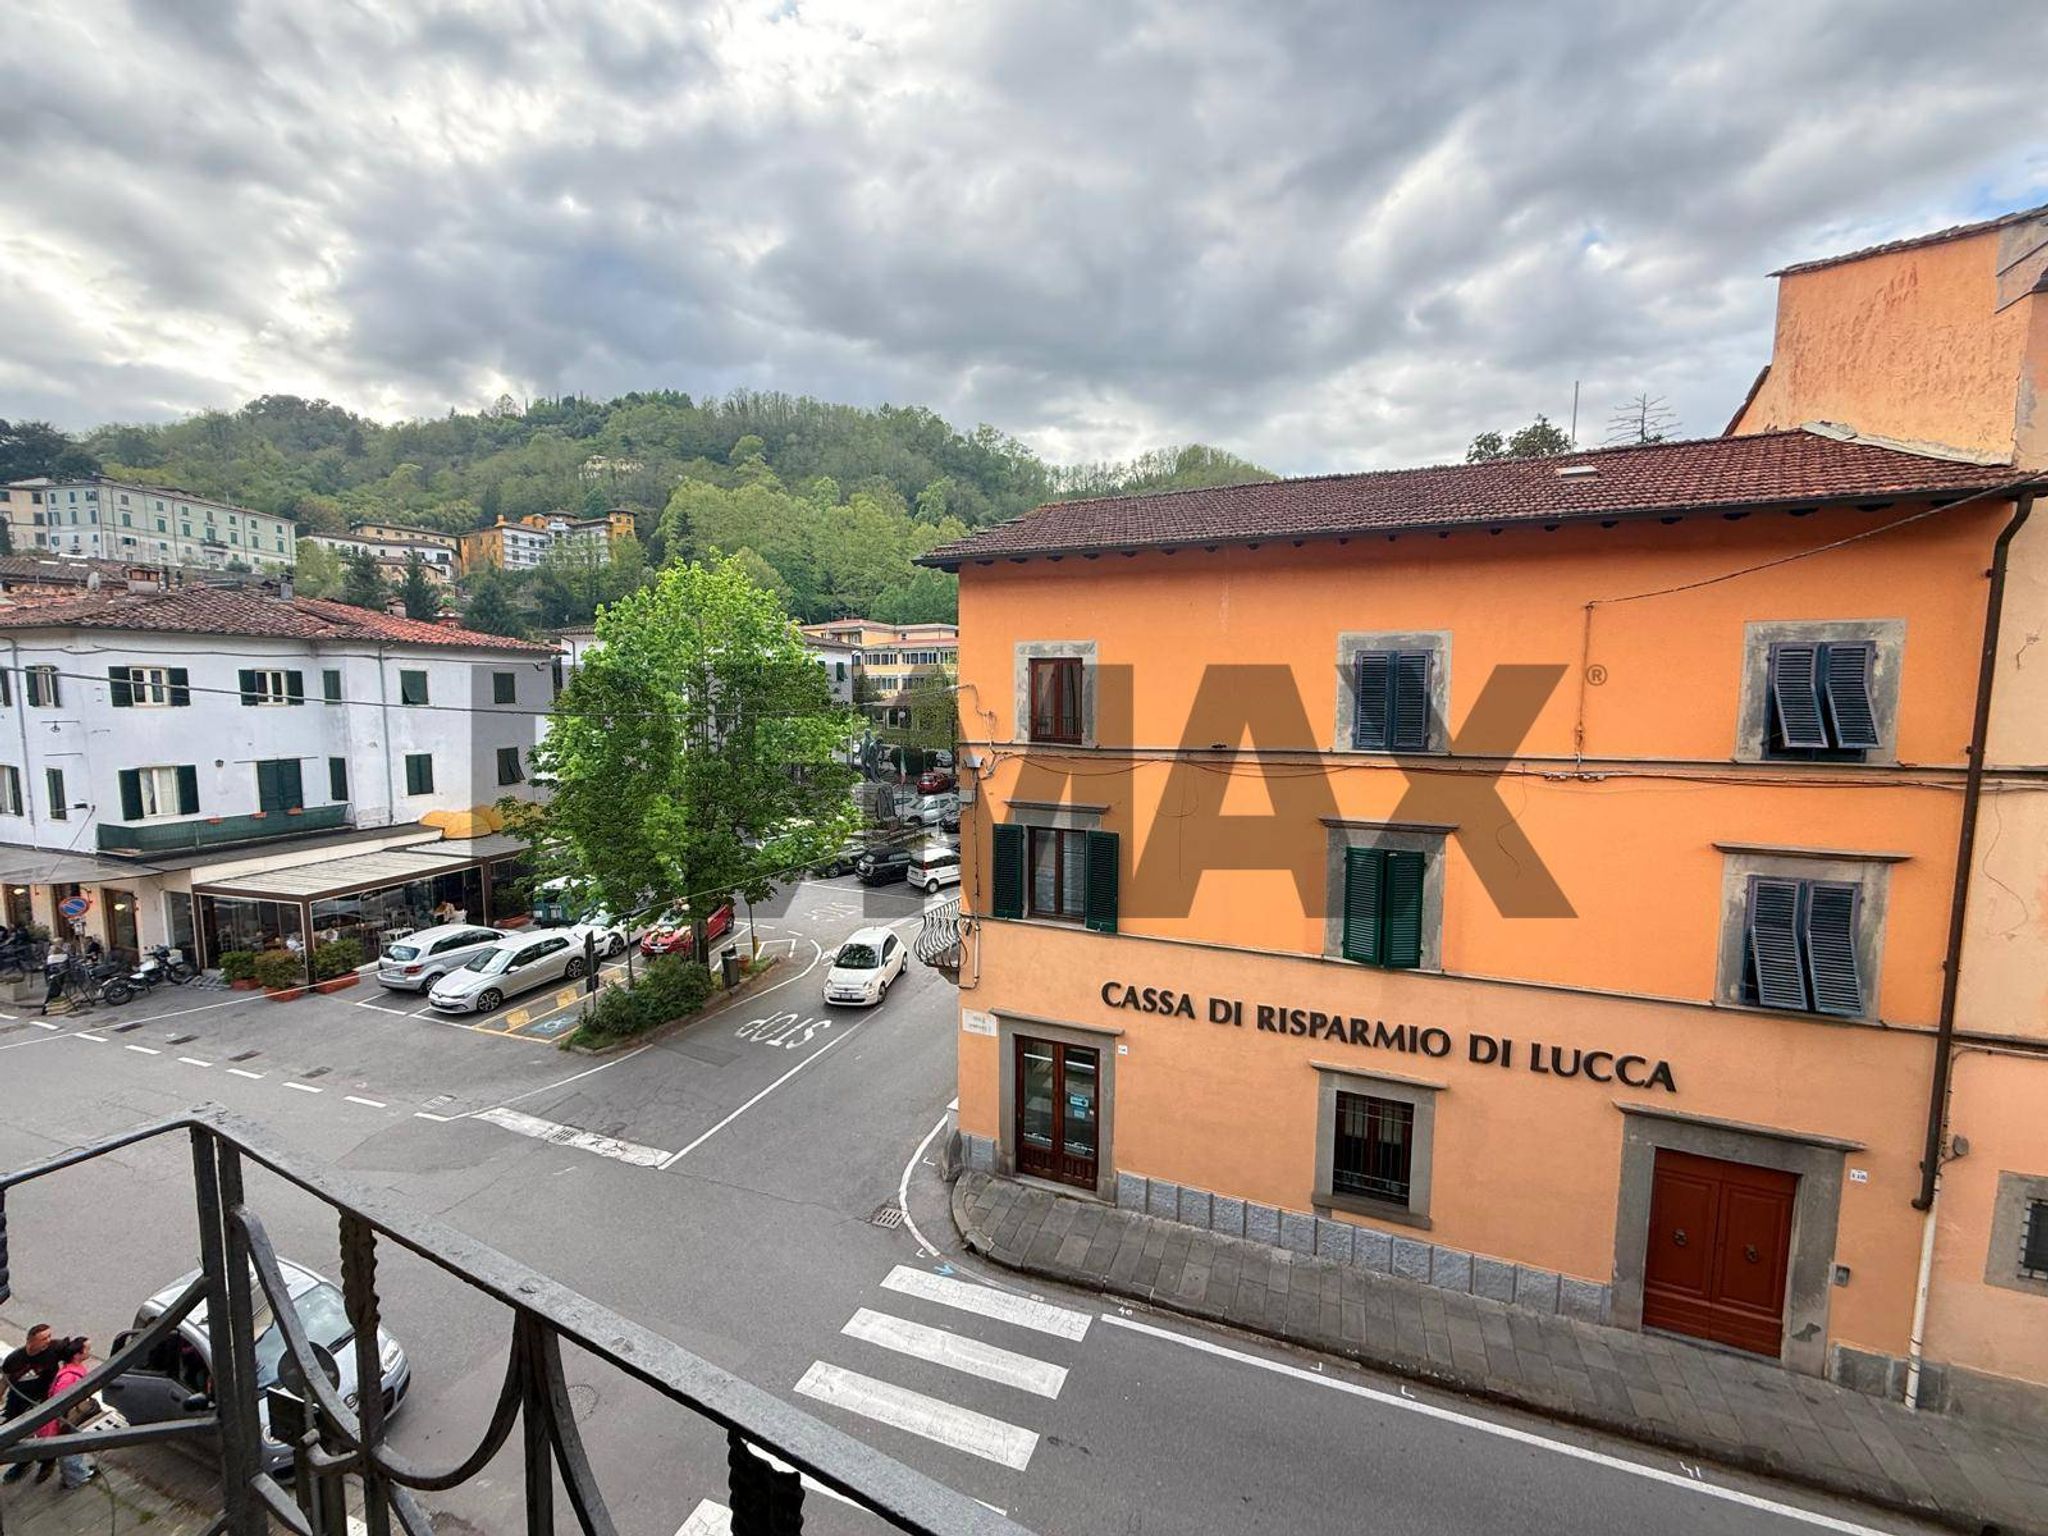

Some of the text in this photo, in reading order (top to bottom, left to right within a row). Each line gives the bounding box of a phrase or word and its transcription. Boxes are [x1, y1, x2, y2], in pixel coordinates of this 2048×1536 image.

[734, 1011, 833, 1050] STOP
[1101, 981, 1677, 1094] CASSA DI RISPARMIO DI LUCCA
